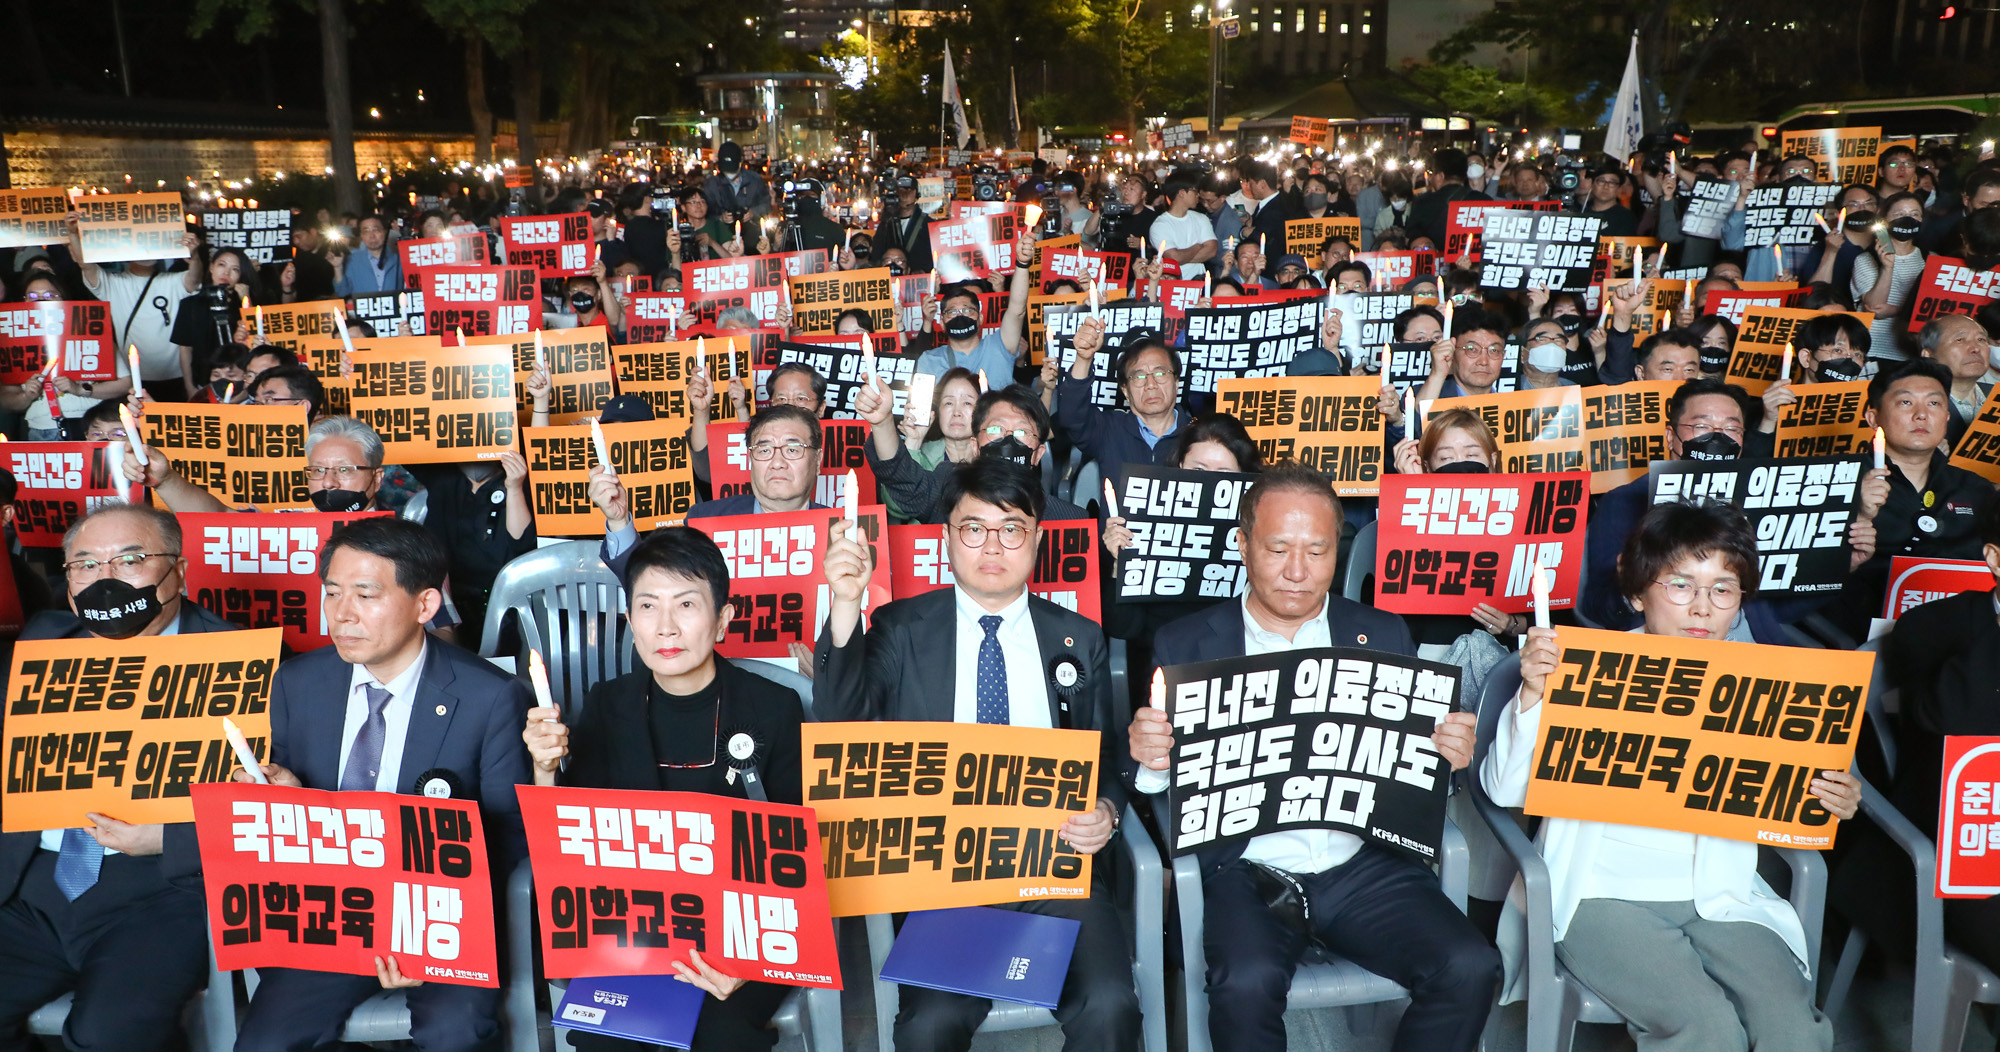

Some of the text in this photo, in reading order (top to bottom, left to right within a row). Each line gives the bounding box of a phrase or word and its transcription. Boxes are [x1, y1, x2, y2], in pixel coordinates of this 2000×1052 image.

[1784, 136, 1880, 159] 고집불통 의대증원
[1692, 180, 1733, 200] 무너진
[1745, 187, 1783, 208] 무너진
[79, 201, 181, 225] 고집불통 의대증원
[203, 212, 239, 229] 무너진
[1687, 198, 1736, 219] 국민도
[1745, 208, 1787, 227] 국민도
[206, 229, 290, 248] 국민도 의사도
[511, 216, 588, 244] 국민건강 사망
[939, 220, 987, 248] 국민건강
[991, 214, 1014, 242] 사망
[1288, 223, 1323, 241] 고집불통
[1485, 215, 1601, 242] 무너진 의료정책
[1745, 226, 1815, 247] 희망 없다
[408, 237, 485, 267] 국민건강 사망
[561, 243, 587, 270] 사망
[989, 243, 1012, 271] 사망
[1105, 255, 1128, 280] 사망
[1416, 253, 1435, 276] 사망
[1483, 241, 1595, 268] 국민도 의사도
[434, 274, 498, 302] 국민건강
[503, 270, 536, 301] 사망
[693, 258, 782, 293] 국민건강 사망
[794, 278, 890, 305] 고집불통 의대증원
[1480, 263, 1568, 291] 희망 없다
[0, 306, 105, 339] 국민건강 사망
[356, 296, 394, 317] 무너진
[430, 310, 490, 336] 의학교육
[497, 305, 530, 336] 사망
[635, 297, 685, 319] 국민건강
[751, 291, 778, 320] 사망
[903, 305, 924, 333] 사망
[1100, 306, 1162, 333] 의료정책
[1188, 302, 1317, 341] 무너진 의료정책
[1354, 295, 1413, 321] 의료정책
[245, 312, 294, 336] 고집불통
[64, 340, 99, 372] 사망
[544, 341, 606, 375] 의대증원
[619, 352, 681, 382] 고집불통
[1191, 334, 1315, 370] 국민도 의사도
[353, 360, 510, 400] 고집불통 의대증원
[548, 383, 610, 415] 의료사망
[1222, 389, 1381, 432] 고집불통 의대증원
[1585, 391, 1660, 429] 고집불통
[1781, 391, 1862, 428] 고집불통
[146, 415, 306, 458] 고집불통 의대증원
[437, 410, 514, 448] 의료사망
[1503, 403, 1580, 443] 의대증원
[611, 436, 687, 475] 의대증원
[820, 425, 866, 470] 사망
[1301, 445, 1381, 483] 의료사망
[1590, 435, 1664, 473] 대한민국
[1690, 449, 1723, 461] 의학교육
[11, 452, 84, 490] 국민건강
[232, 470, 310, 505] 의료사망
[1743, 461, 1861, 509] 의료정책
[1123, 476, 1203, 518] 무너진
[1400, 480, 1583, 536] 국민건강 사망
[14, 499, 80, 534] 의학교육
[1756, 510, 1850, 550] 의사도
[203, 526, 319, 575] 국민건강
[713, 524, 816, 580] 국민건강
[1033, 527, 1090, 584] 사망
[1124, 520, 1214, 559] 국민도
[1121, 558, 1191, 597] 희망
[1381, 541, 1563, 598] 의학교육 사망
[84, 598, 149, 622] 의학교육 사망
[10, 656, 275, 720] 고집불통 의대증원
[1173, 658, 1456, 735] 무너진 의료정책
[1548, 647, 1863, 745] 고집불통 의대증원
[7, 730, 134, 794] 대한민국
[1176, 722, 1440, 791] 국민도 의사도
[1535, 724, 1692, 794] 대한민국
[809, 741, 1093, 812] 고집불통 의대증원
[1176, 776, 1376, 850] 희망 없다
[232, 801, 473, 878] 국민건강 사망
[556, 805, 808, 888] 국민건강 사망
[817, 815, 946, 880] 대한민국
[222, 881, 463, 960] 의학교육 사망
[551, 886, 799, 965] 의학교육 사망
